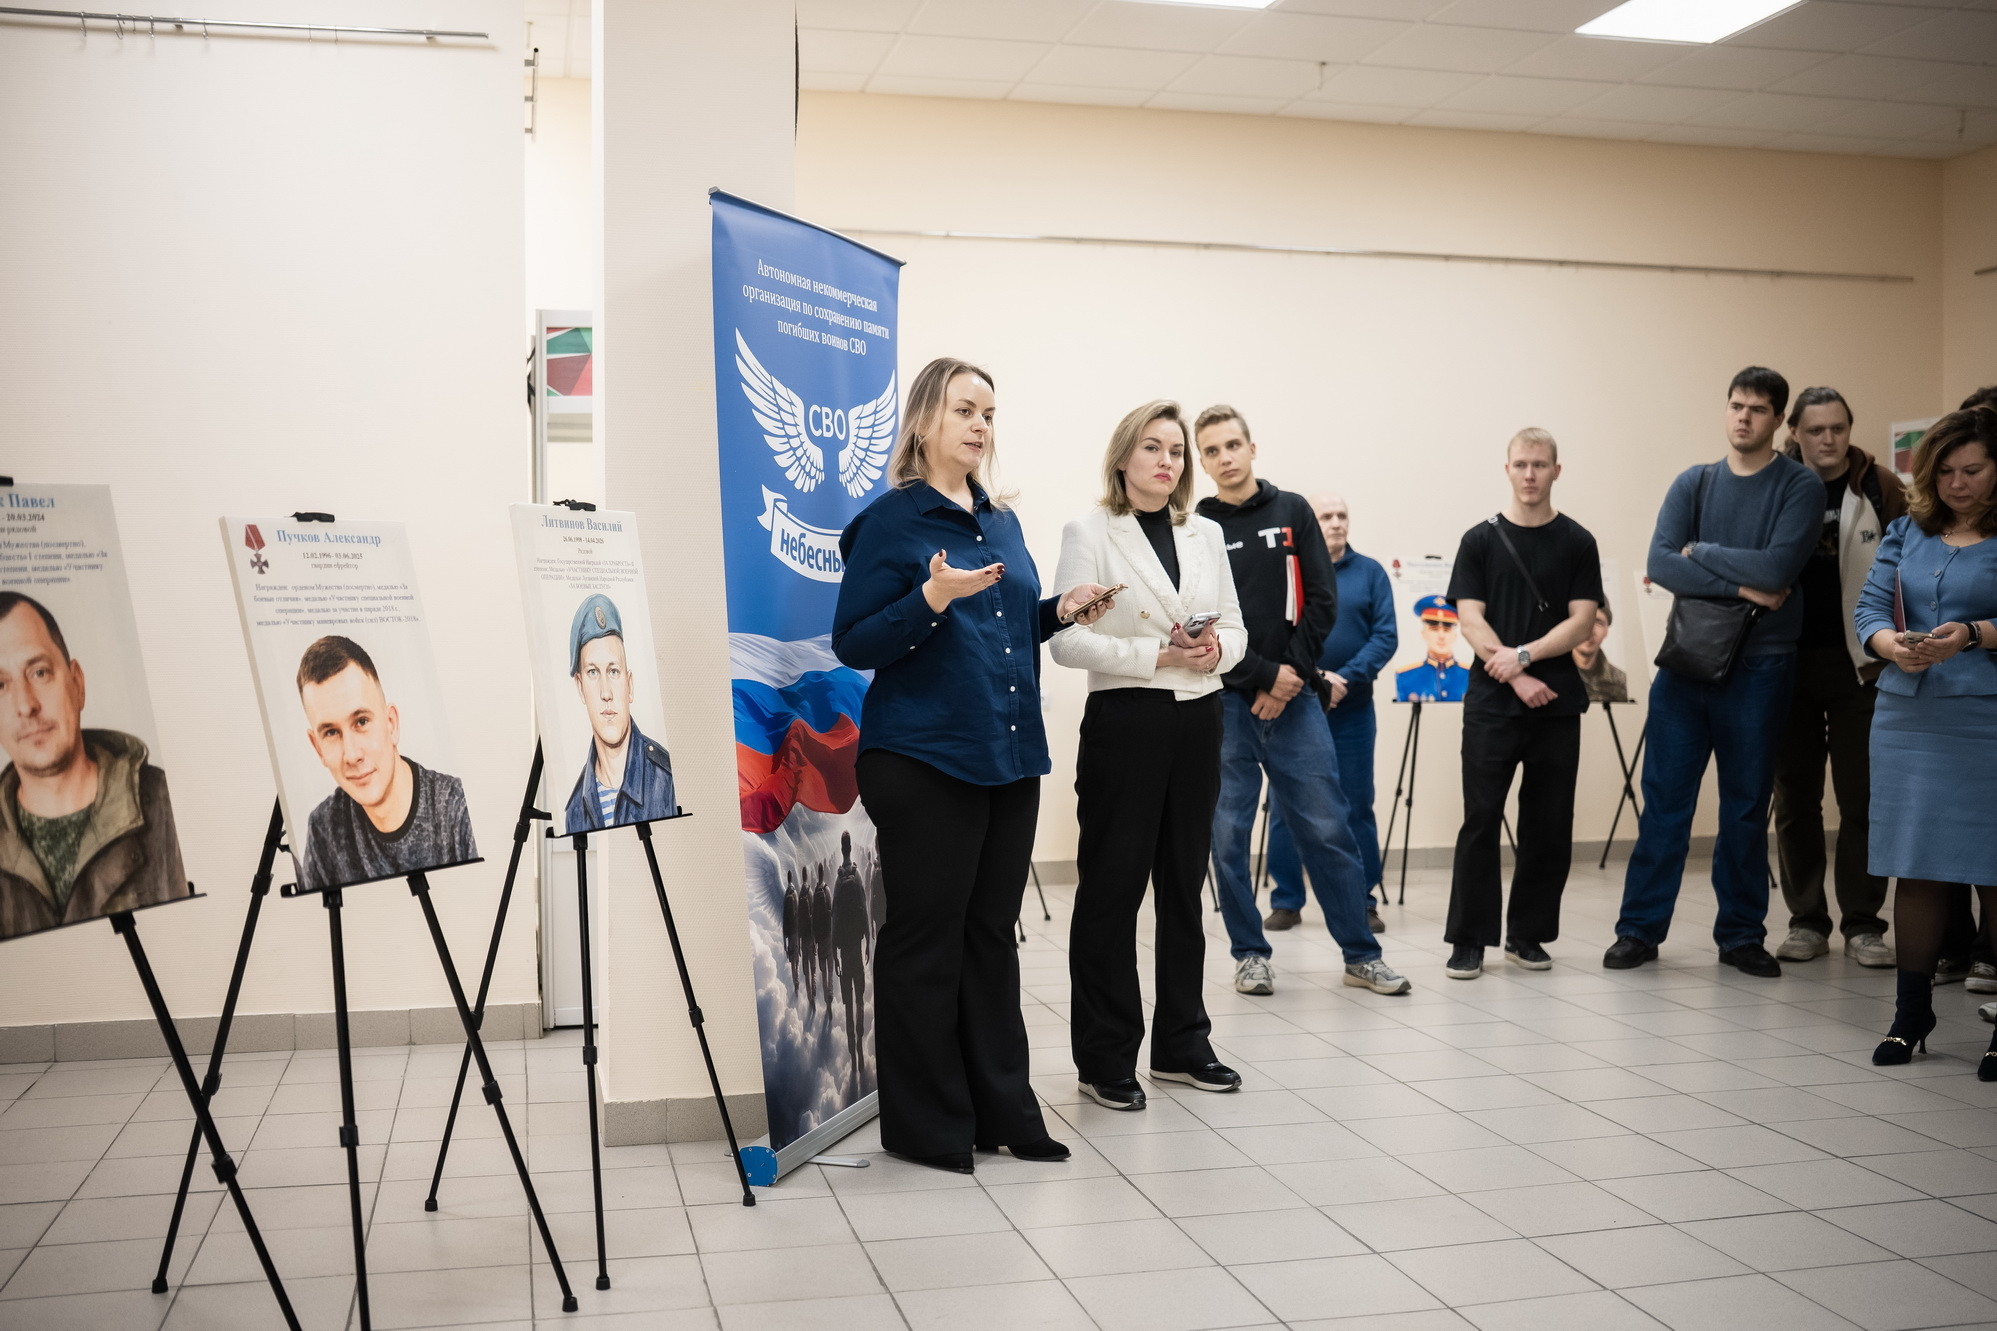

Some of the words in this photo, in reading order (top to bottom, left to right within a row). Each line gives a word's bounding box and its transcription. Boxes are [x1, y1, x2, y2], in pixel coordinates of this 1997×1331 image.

[757, 258, 811, 290] Автономная
[813, 281, 878, 312] некоммерческая
[742, 284, 801, 313] организация
[802, 302, 813, 316] по
[814, 306, 862, 331] сохранению
[863, 321, 890, 340] памяти
[777, 320, 820, 343] погибших
[822, 332, 849, 351] воинов
[849, 337, 867, 356] СВО
[808, 404, 846, 440] СВО
[8, 493, 56, 508] Павел
[276, 530, 320, 545] Пучков
[324, 532, 381, 547] Александр
[541, 515, 585, 529] Литвинов
[586, 518, 623, 532] Василий
